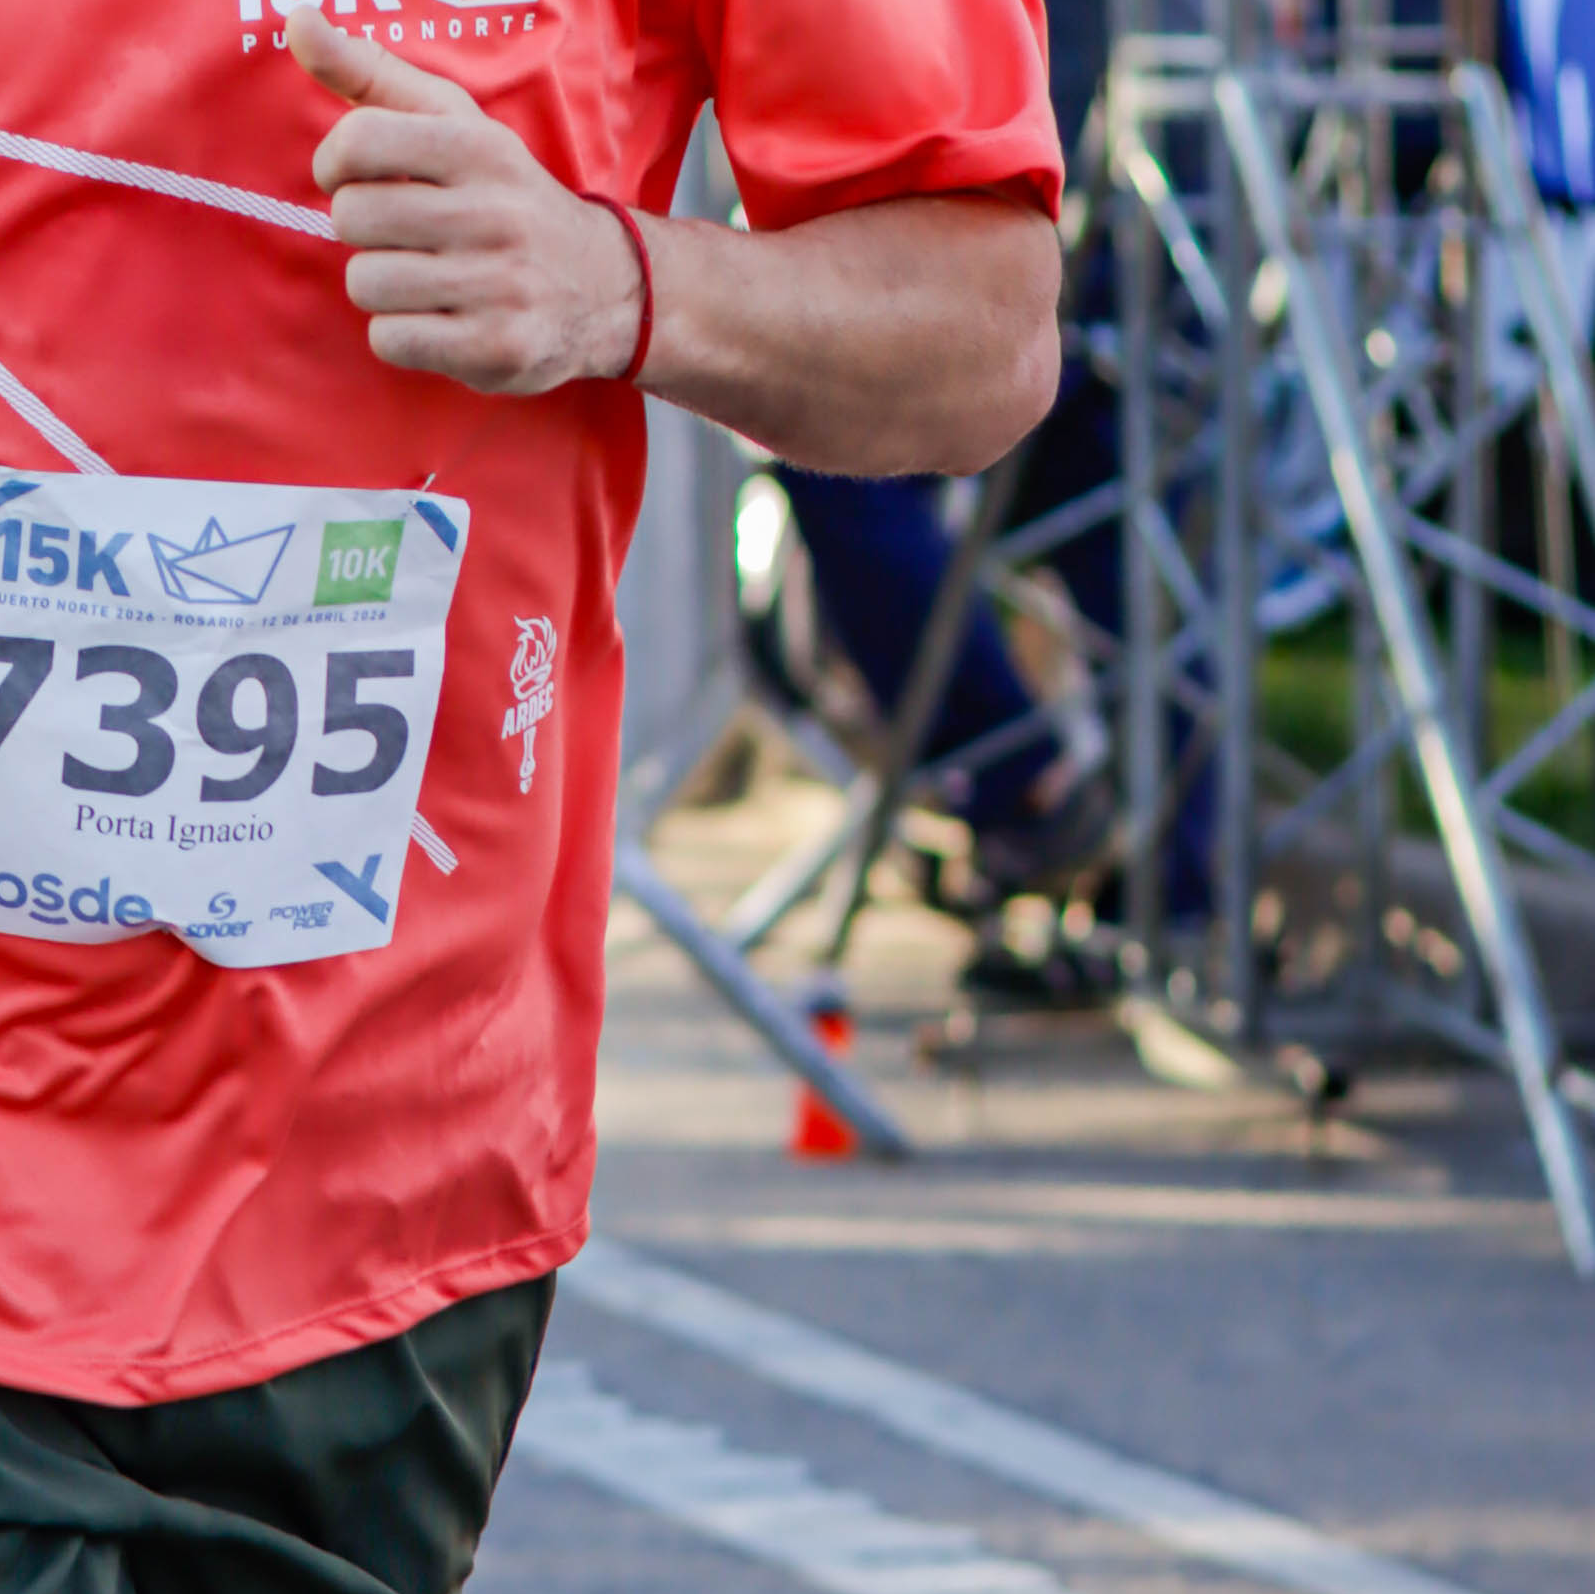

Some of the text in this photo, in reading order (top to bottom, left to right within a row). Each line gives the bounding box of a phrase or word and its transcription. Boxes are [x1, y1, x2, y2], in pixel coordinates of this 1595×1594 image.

[421, 13, 536, 41] NORTE
[328, 546, 388, 582] 10K
[56, 601, 111, 618] NORTE
[115, 608, 156, 623] 2026
[173, 612, 245, 628] ROSARIO
[262, 615, 277, 627] 12
[282, 612, 300, 626] DE
[305, 610, 346, 624] ABRIL
[352, 608, 387, 622] 2026
[501, 681, 555, 741] ARDEC
[74, 804, 274, 851] Porta Ignacio
[270, 902, 334, 921] POWER
